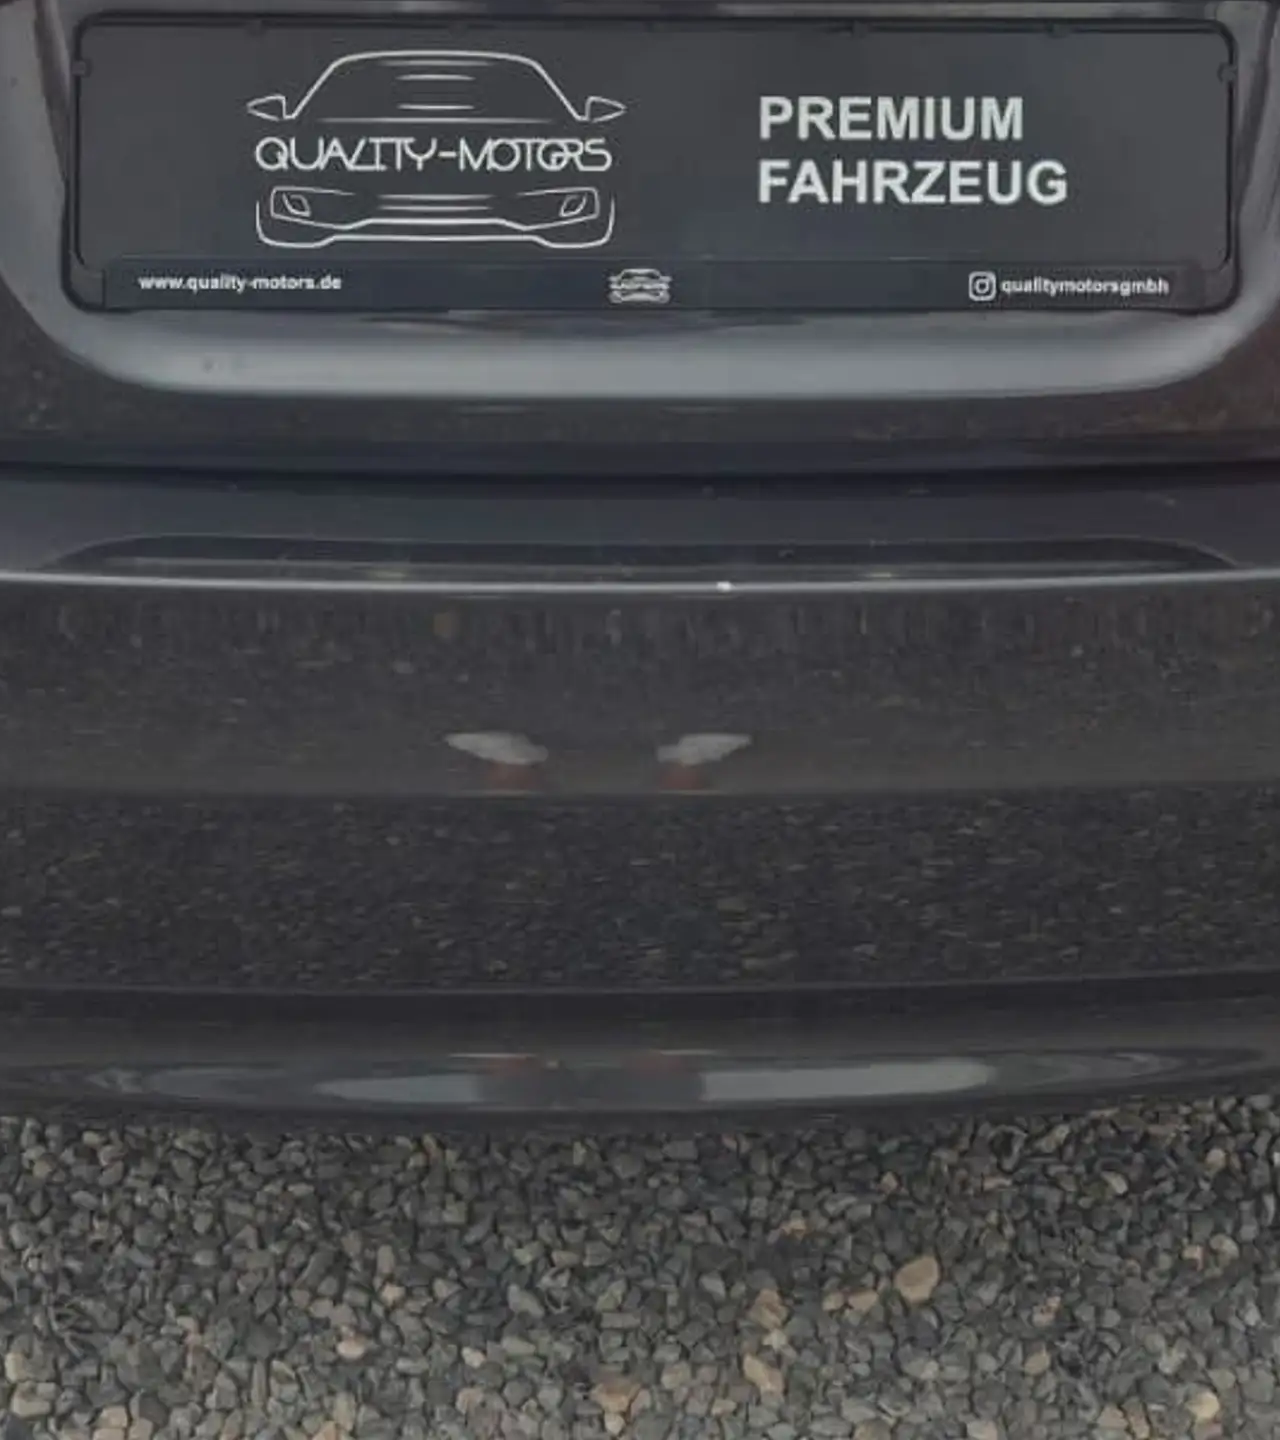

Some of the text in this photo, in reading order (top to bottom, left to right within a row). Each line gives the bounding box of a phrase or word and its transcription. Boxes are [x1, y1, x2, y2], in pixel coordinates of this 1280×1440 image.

[759, 95, 1023, 142] PREMIUM
[254, 136, 613, 172] QUALITY-MOTORS
[758, 160, 1068, 205] FAHRZEUG
[137, 273, 343, 294] www.quality-motors.de
[1000, 275, 1170, 298] qualitymotorsgmbh
